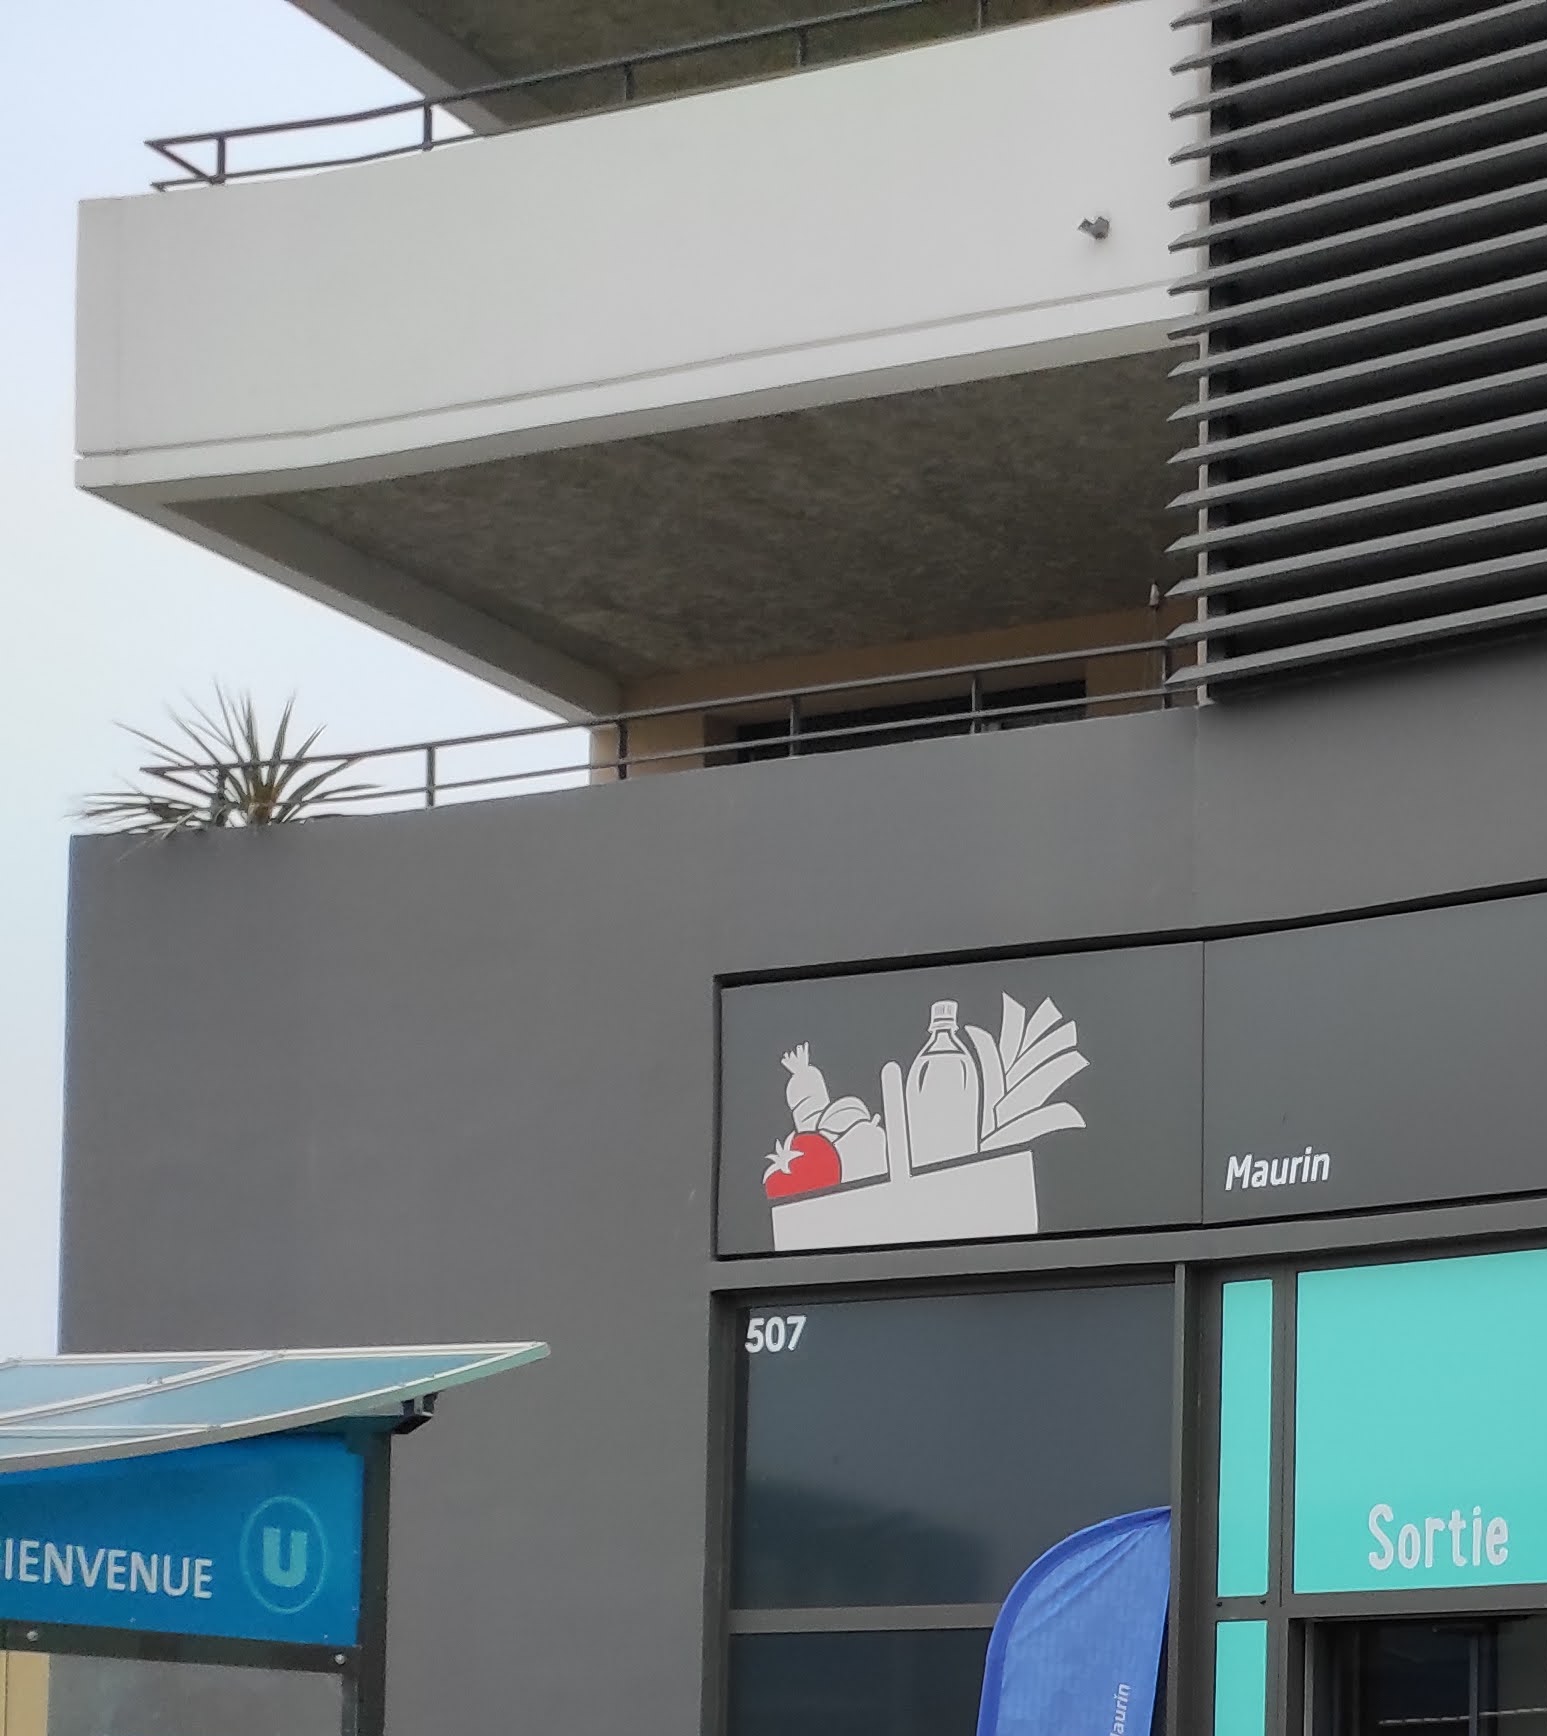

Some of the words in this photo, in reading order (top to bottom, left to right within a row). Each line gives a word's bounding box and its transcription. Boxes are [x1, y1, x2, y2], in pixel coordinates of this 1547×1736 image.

[1225, 1146, 1330, 1191] Maurin
[744, 1314, 807, 1354] 507
[262, 1527, 308, 1588] U
[1368, 1503, 1510, 1571] Sortie
